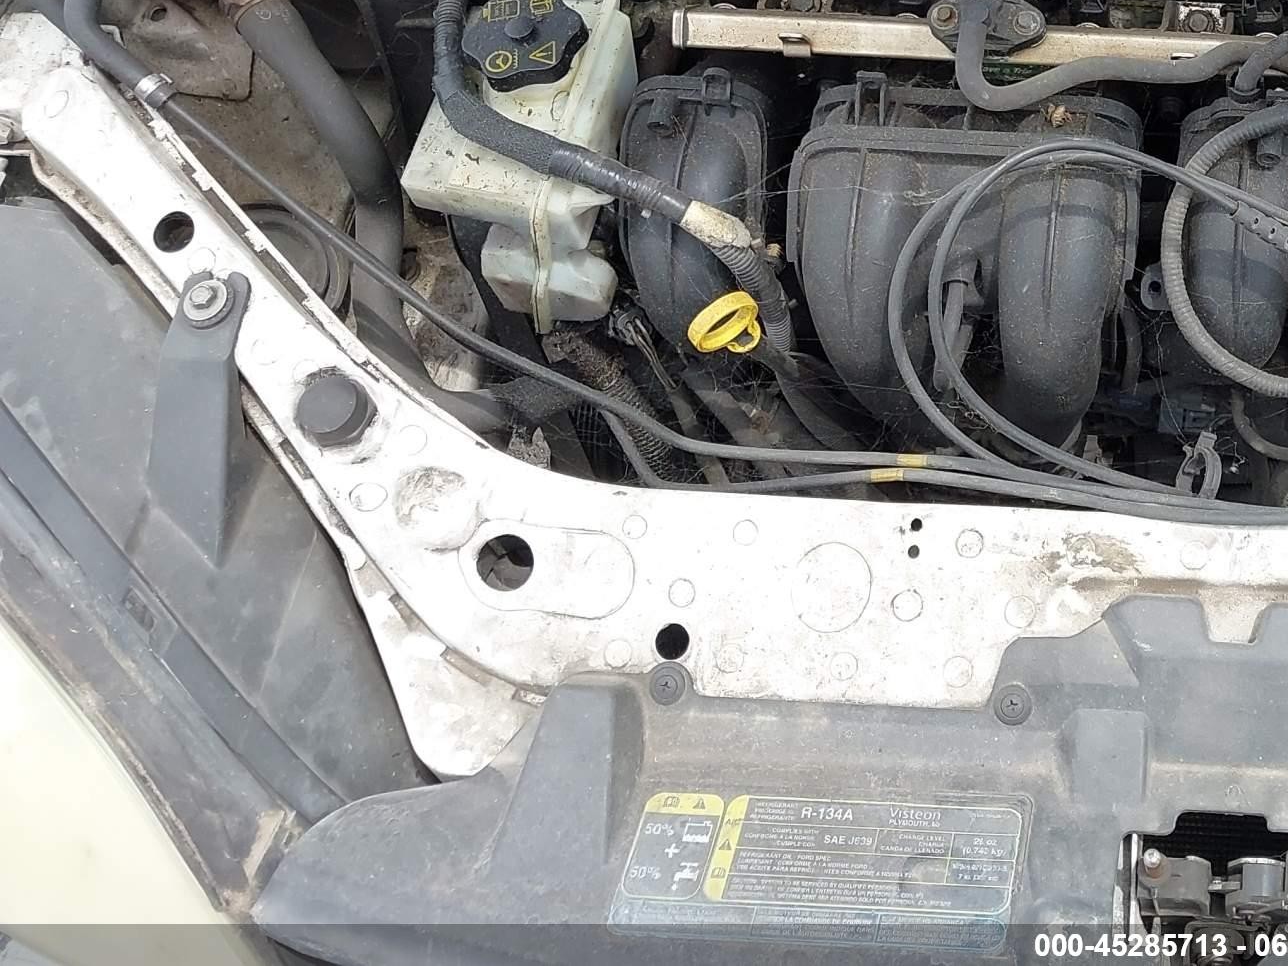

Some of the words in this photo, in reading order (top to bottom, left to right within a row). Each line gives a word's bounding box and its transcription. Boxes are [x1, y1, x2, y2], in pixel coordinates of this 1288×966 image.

[800, 806, 854, 820] R-134A
[890, 807, 941, 820] Visteon
[645, 822, 674, 836] 50%
[824, 834, 846, 845] SAE
[848, 836, 873, 846] J639
[630, 865, 661, 880] 50%
